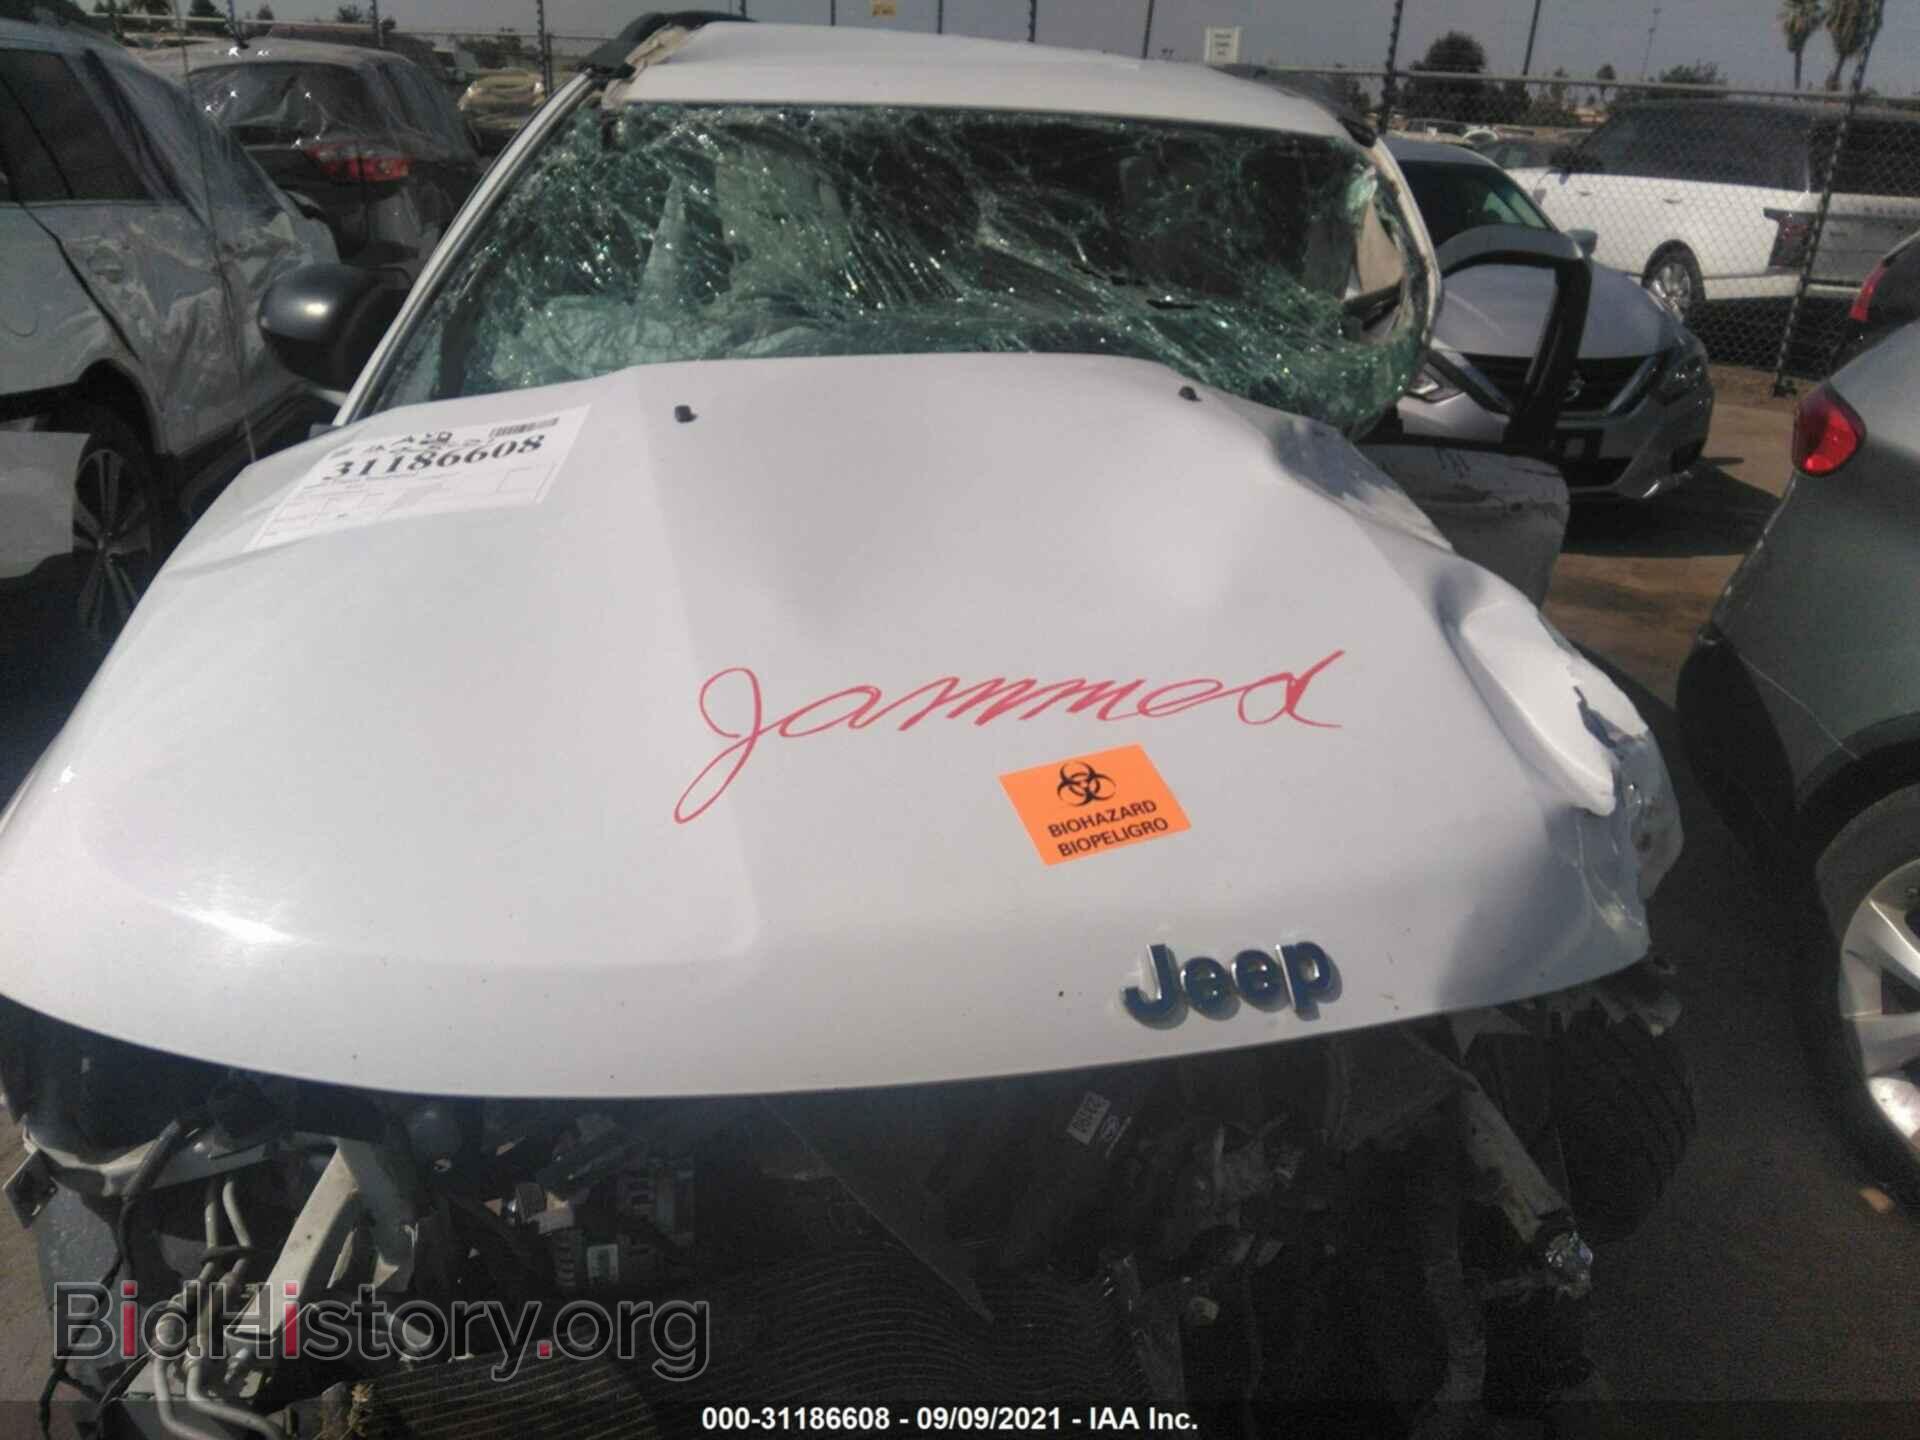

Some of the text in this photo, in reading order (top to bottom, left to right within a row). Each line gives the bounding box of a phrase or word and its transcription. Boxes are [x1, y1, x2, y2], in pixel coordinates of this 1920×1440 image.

[323, 435, 545, 480] 31186608
[675, 650, 1344, 823] Jammed
[1047, 799, 1157, 838] BIOHAZARD
[1057, 817, 1169, 857] BIOPELIGRO
[1120, 941, 1342, 1029] Jeep
